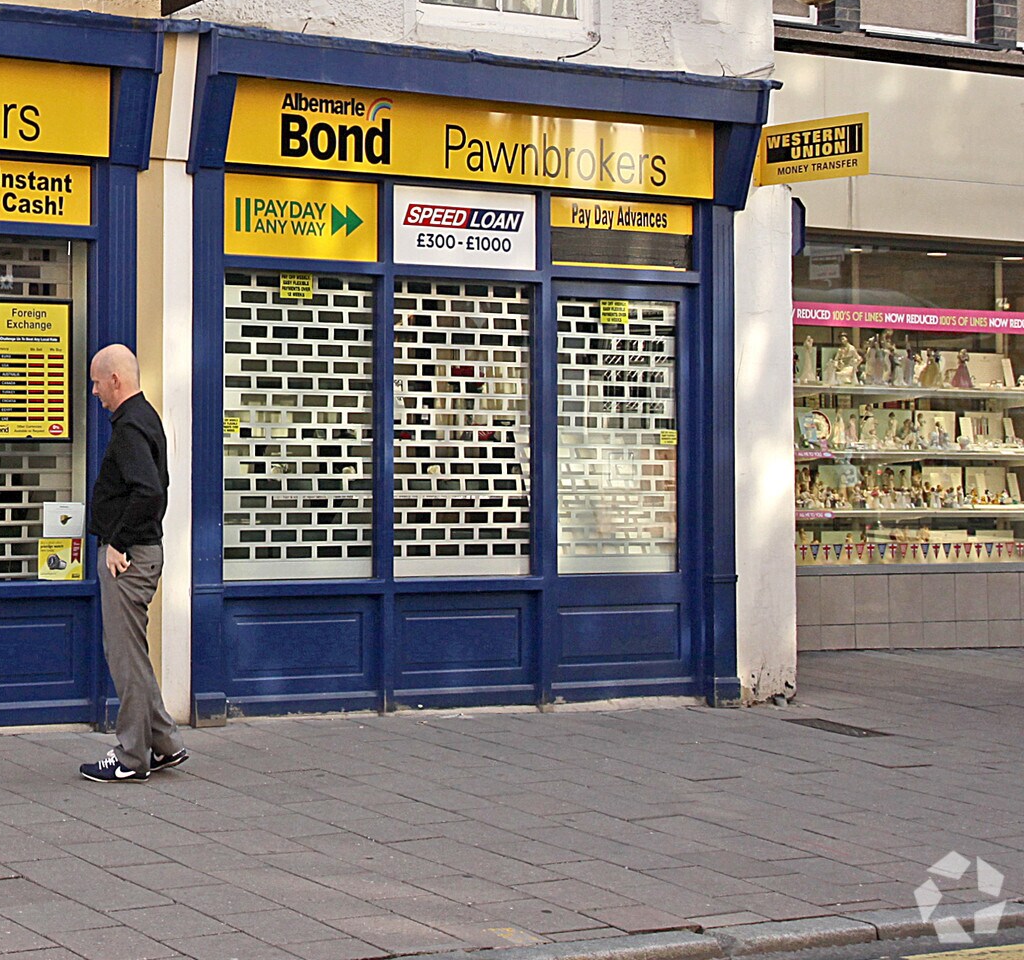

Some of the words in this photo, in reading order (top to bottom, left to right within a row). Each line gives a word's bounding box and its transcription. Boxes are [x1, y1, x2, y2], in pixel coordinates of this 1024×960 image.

[282, 92, 365, 117] Albemarle
[768, 126, 846, 149] WESTERN
[281, 113, 391, 165] Bond
[444, 123, 668, 187] Pawnbrokers
[791, 140, 846, 159] UNION
[777, 165, 808, 176] MONEY
[811, 158, 858, 172] TRANSFER
[2, 192, 64, 216] Cash!
[254, 198, 326, 220] PAYDAY
[406, 206, 467, 228] SPEED
[470, 212, 523, 232] LOAN
[572, 202, 590, 226] Pay
[595, 205, 613, 229] Day
[617, 208, 668, 228] Advances
[254, 218, 289, 234] ANY
[291, 220, 326, 236] WAY
[12, 308, 47, 319] Foreign
[797, 308, 831, 320] REDUCED
[832, 310, 851, 321] 100'S
[852, 311, 863, 321] OF
[864, 312, 883, 322] LINES
[884, 313, 905, 323] NOW
[906, 314, 938, 325] REDUCED
[939, 315, 956, 326] 100'S
[957, 316, 968, 326] OF
[969, 317, 988, 327] LINES
[988, 318, 1008, 328] NOW
[6, 320, 52, 331] Exchange
